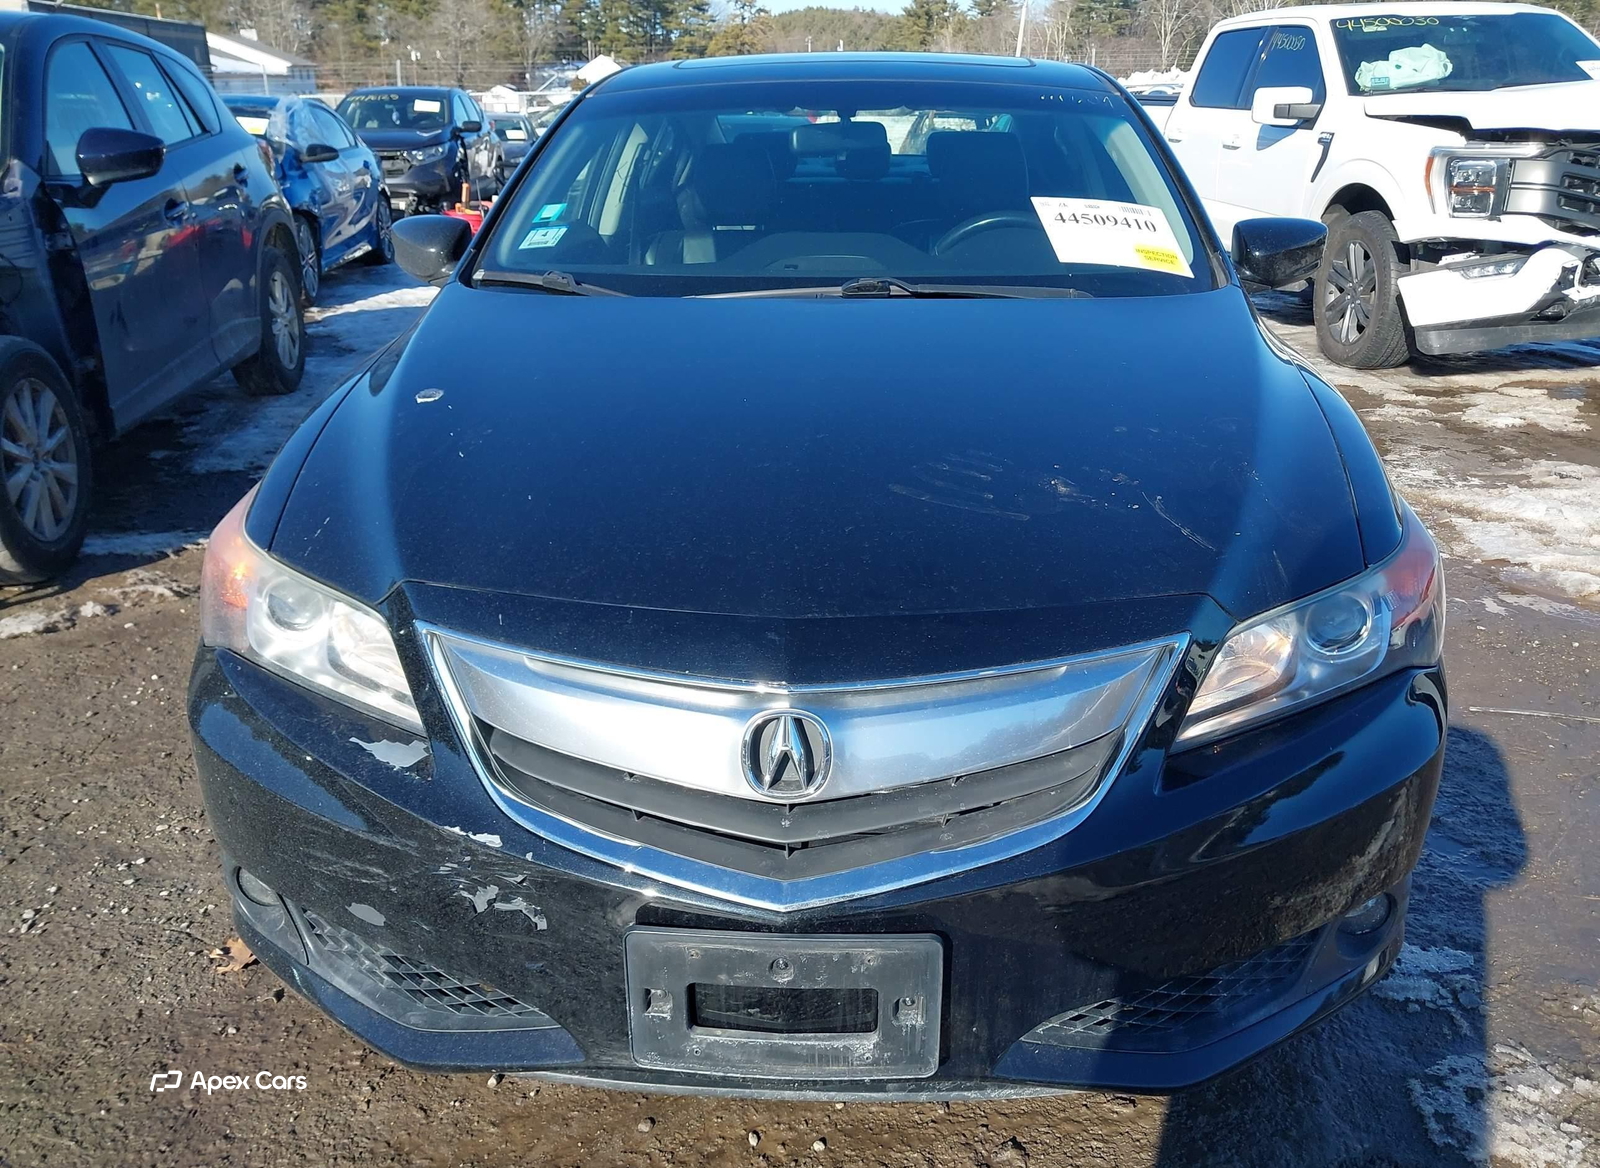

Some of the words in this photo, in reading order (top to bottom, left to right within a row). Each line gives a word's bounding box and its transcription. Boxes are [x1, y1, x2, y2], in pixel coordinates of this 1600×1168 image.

[1336, 17, 1440, 31] 44500030
[1054, 212, 1158, 233] 44509410
[1135, 248, 1178, 260] INSPECTION
[1143, 255, 1176, 265] SERVICE
